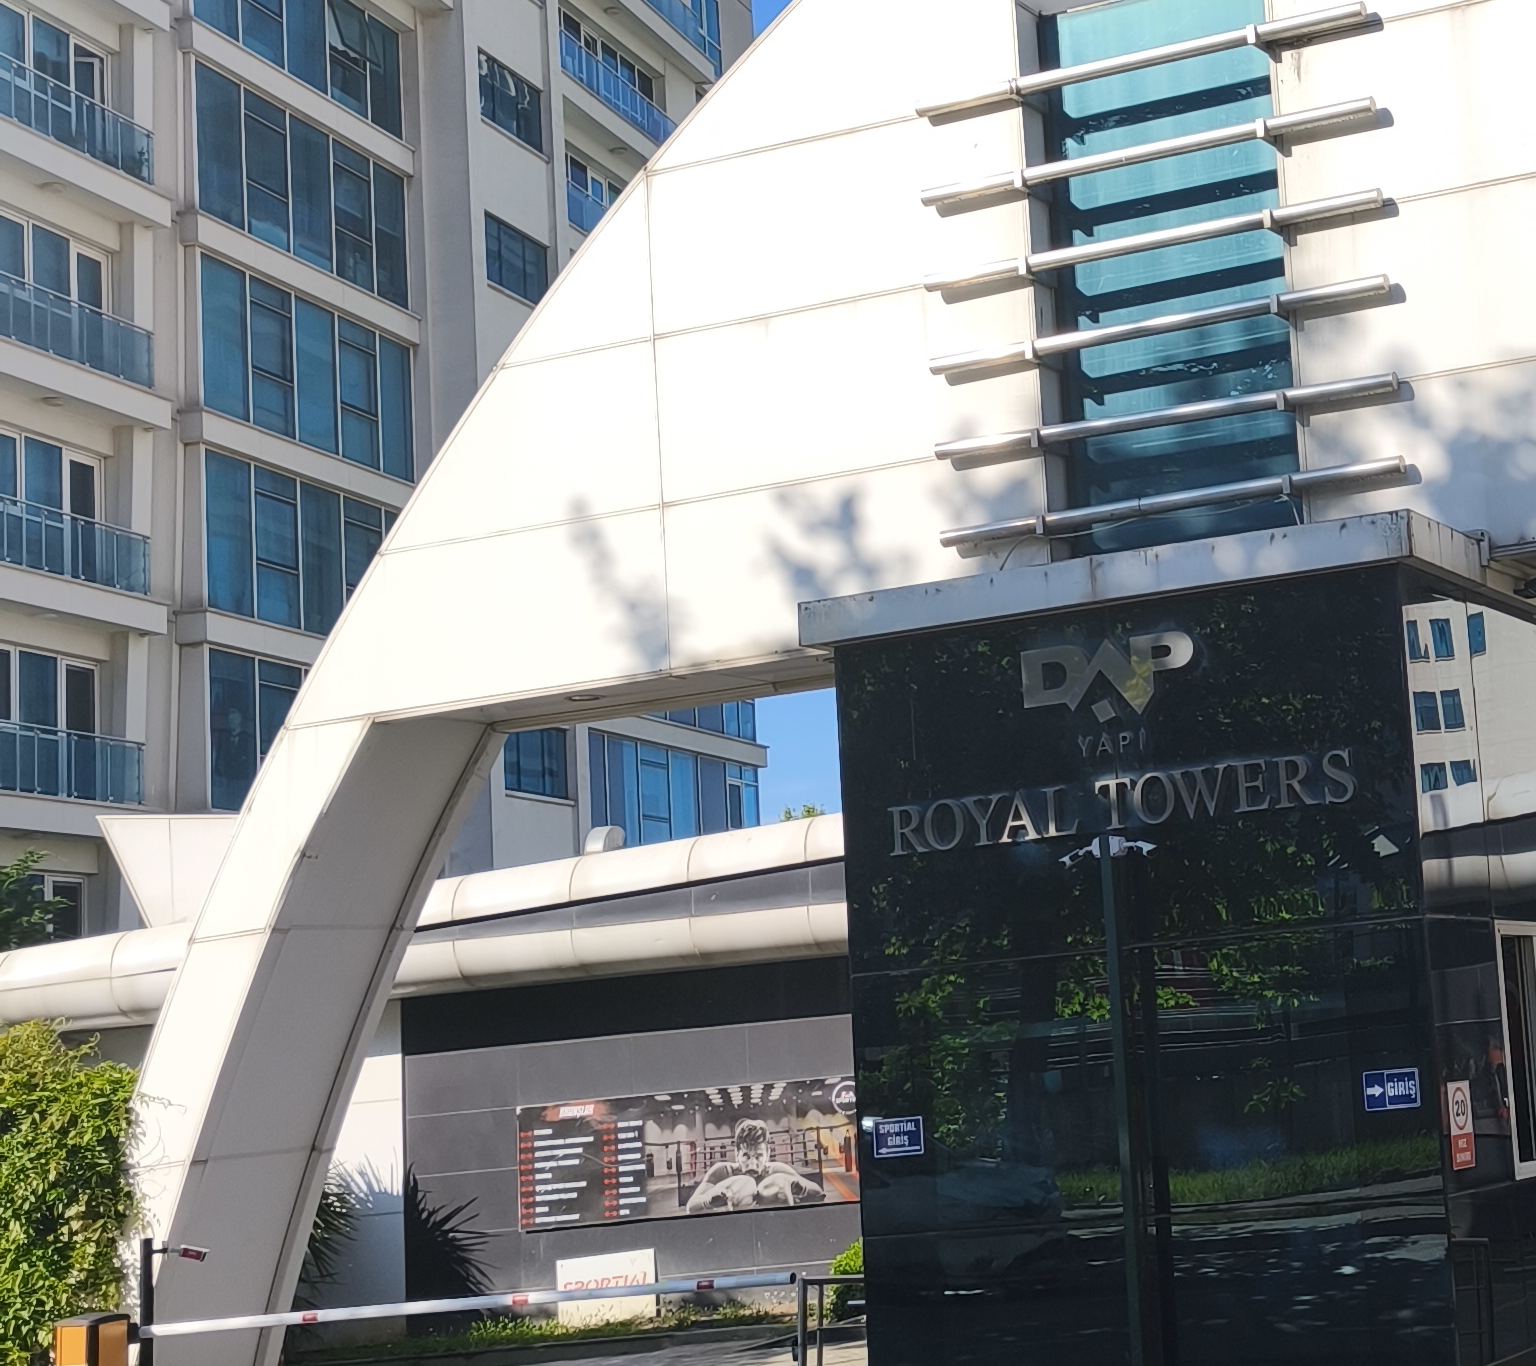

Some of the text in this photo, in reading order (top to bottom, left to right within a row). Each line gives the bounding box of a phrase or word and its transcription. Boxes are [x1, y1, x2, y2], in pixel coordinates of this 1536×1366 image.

[1020, 630, 1194, 715] DAP
[887, 748, 1357, 856] ROYAL TOWERS
[1387, 1077, 1416, 1098] GİRİŞ
[1455, 1099, 1466, 1117] 20
